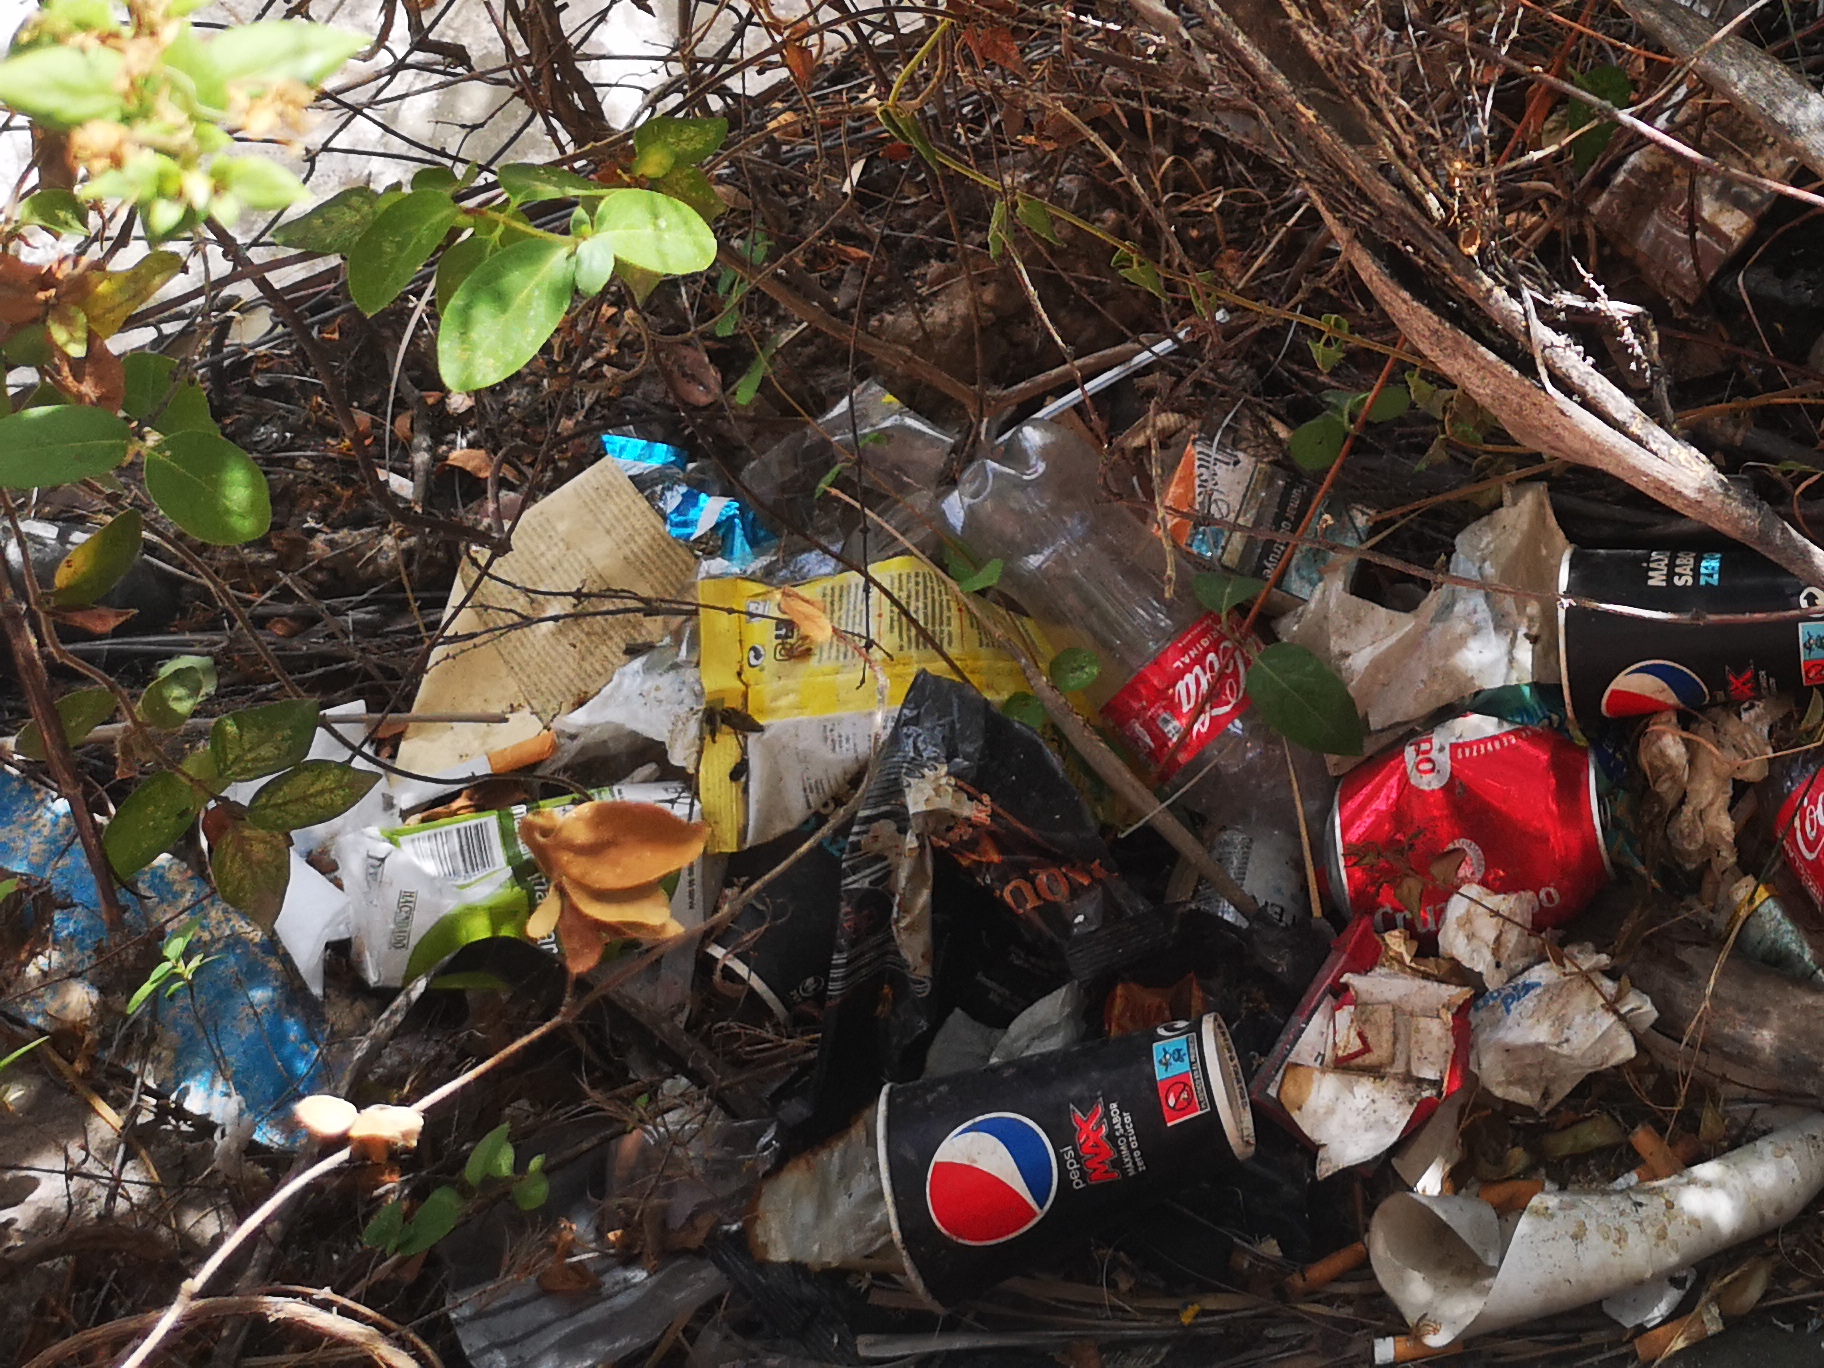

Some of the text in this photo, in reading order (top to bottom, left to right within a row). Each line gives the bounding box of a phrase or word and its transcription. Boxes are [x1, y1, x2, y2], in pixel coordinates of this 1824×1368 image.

[1069, 1095, 1122, 1185] MAX
[1109, 1100, 1125, 1136] SABOR
[1122, 1111, 1147, 1172] zero azúcar
[1060, 1144, 1087, 1190] pepsi
